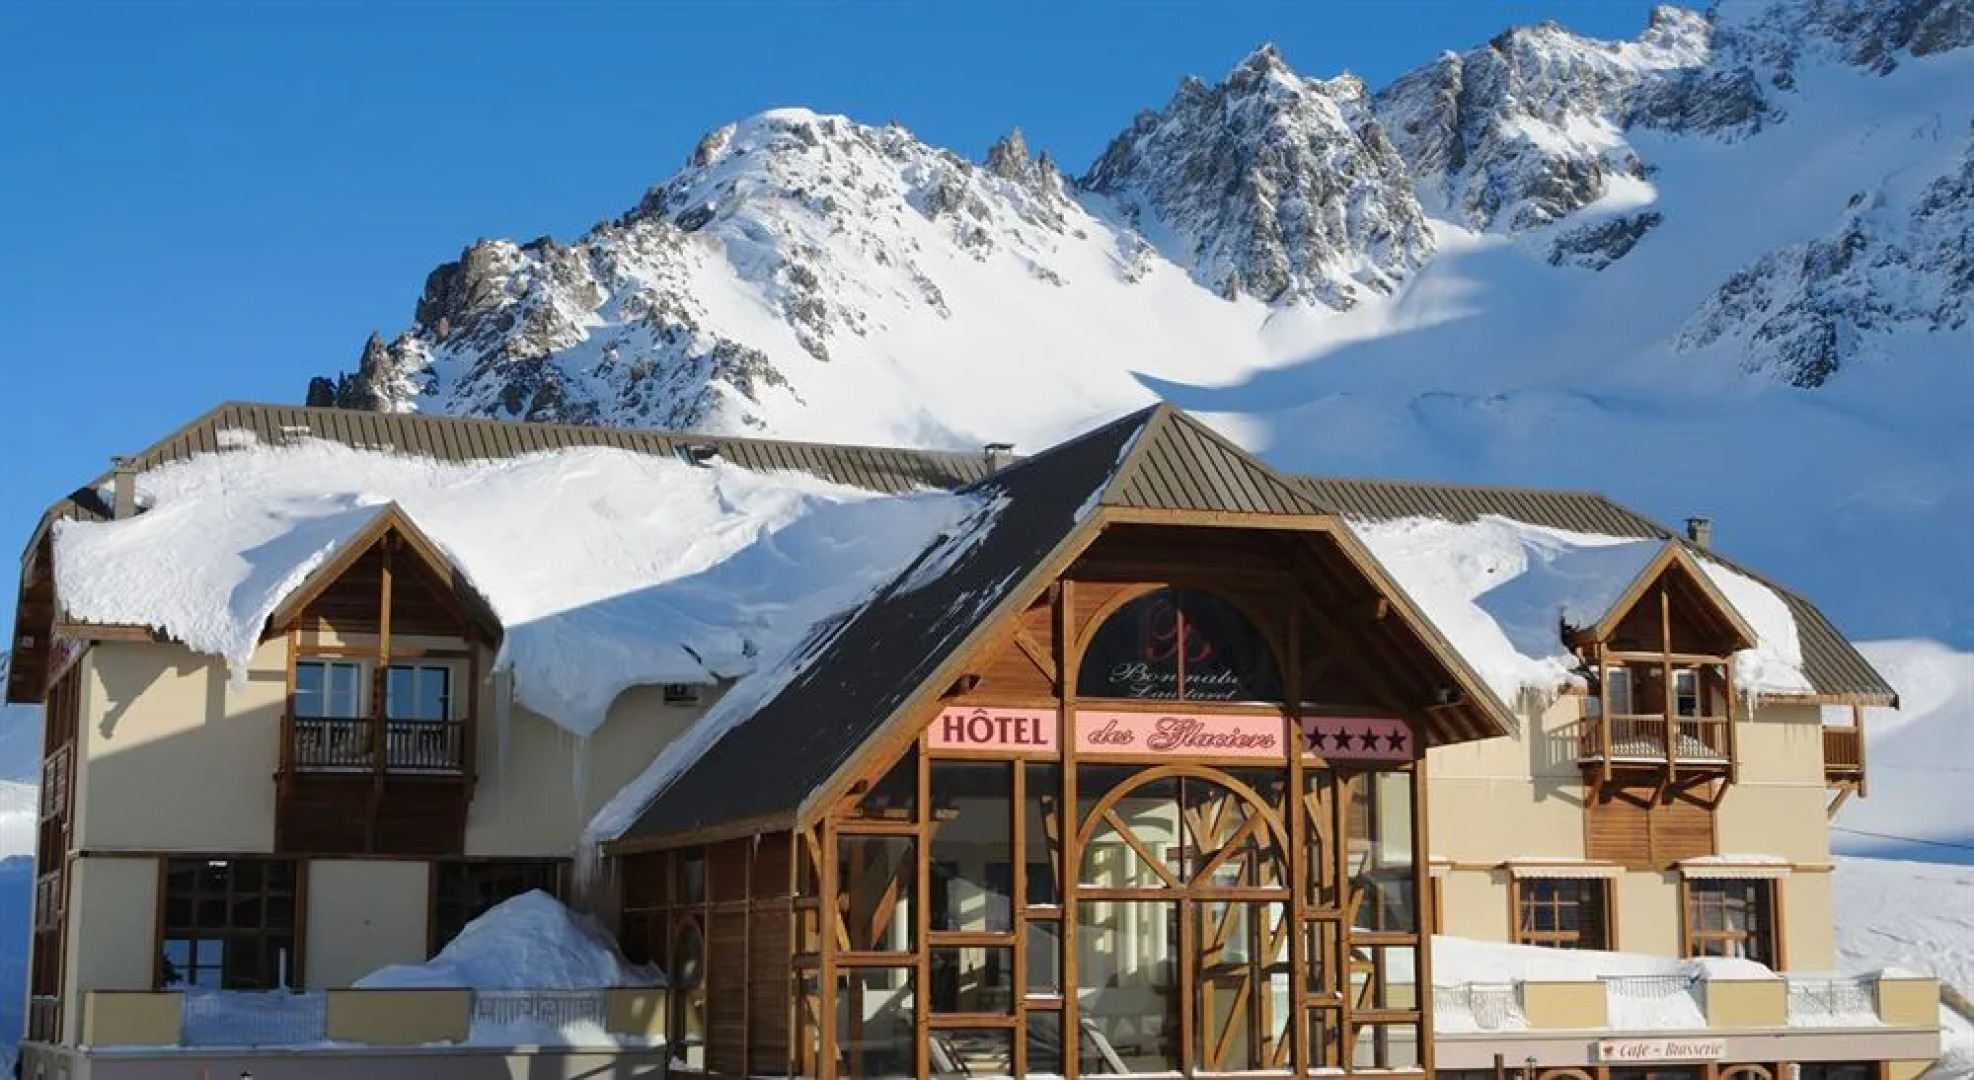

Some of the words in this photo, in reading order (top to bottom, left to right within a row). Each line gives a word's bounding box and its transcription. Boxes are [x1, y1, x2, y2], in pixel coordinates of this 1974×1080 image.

[943, 708, 1049, 744] HÔTEL
[1087, 718, 1135, 745] des
[1147, 716, 1276, 751] Glaciers
[1665, 1042, 1722, 1057] Brasserie
